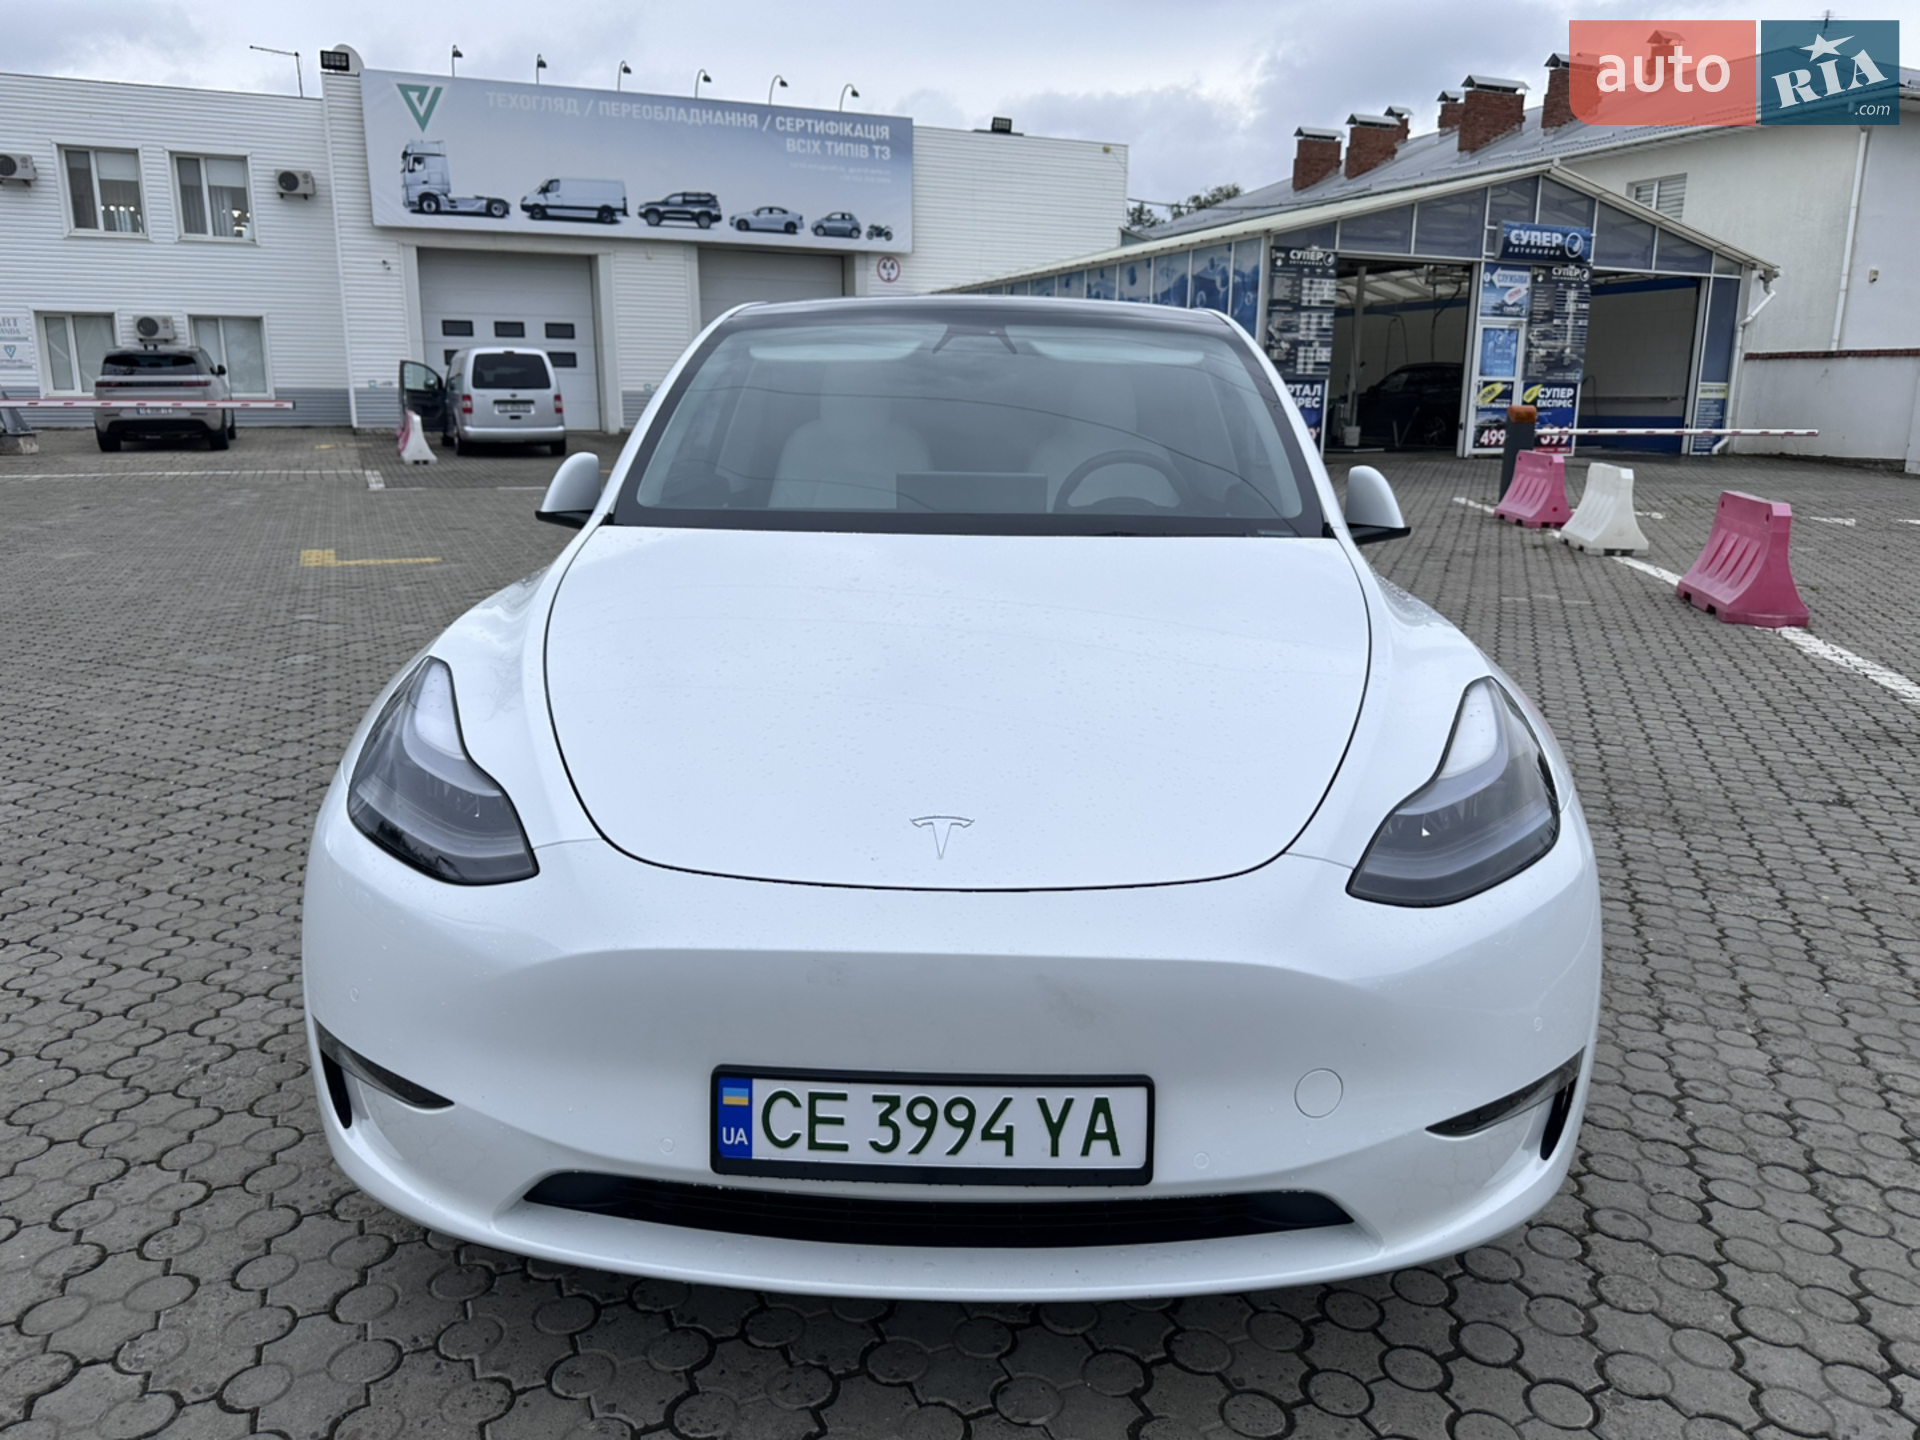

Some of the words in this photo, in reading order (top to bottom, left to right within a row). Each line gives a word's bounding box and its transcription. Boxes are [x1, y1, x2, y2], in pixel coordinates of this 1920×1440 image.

[485, 91, 580, 116] ТЕХОГЛЯД
[599, 101, 758, 129] ПЕРЕОБЛАДНАННЯ
[775, 116, 890, 142] СЕРТИФІКАЦІЯ
[786, 138, 821, 155] ВСІХ
[825, 141, 869, 159] ТИПІВ
[1510, 229, 1563, 248] СУПЕР
[1289, 249, 1324, 261] СУПЕР
[1552, 266, 1580, 276] СУПЕР
[1539, 387, 1574, 399] СУПЕР
[1537, 399, 1573, 408] ЕКСПРЕС
[1480, 429, 1506, 446] 499
[762, 1089, 849, 1152] CE
[869, 1093, 1014, 1157] 3994
[1037, 1096, 1121, 1158] YA
[722, 1127, 748, 1146] UA
